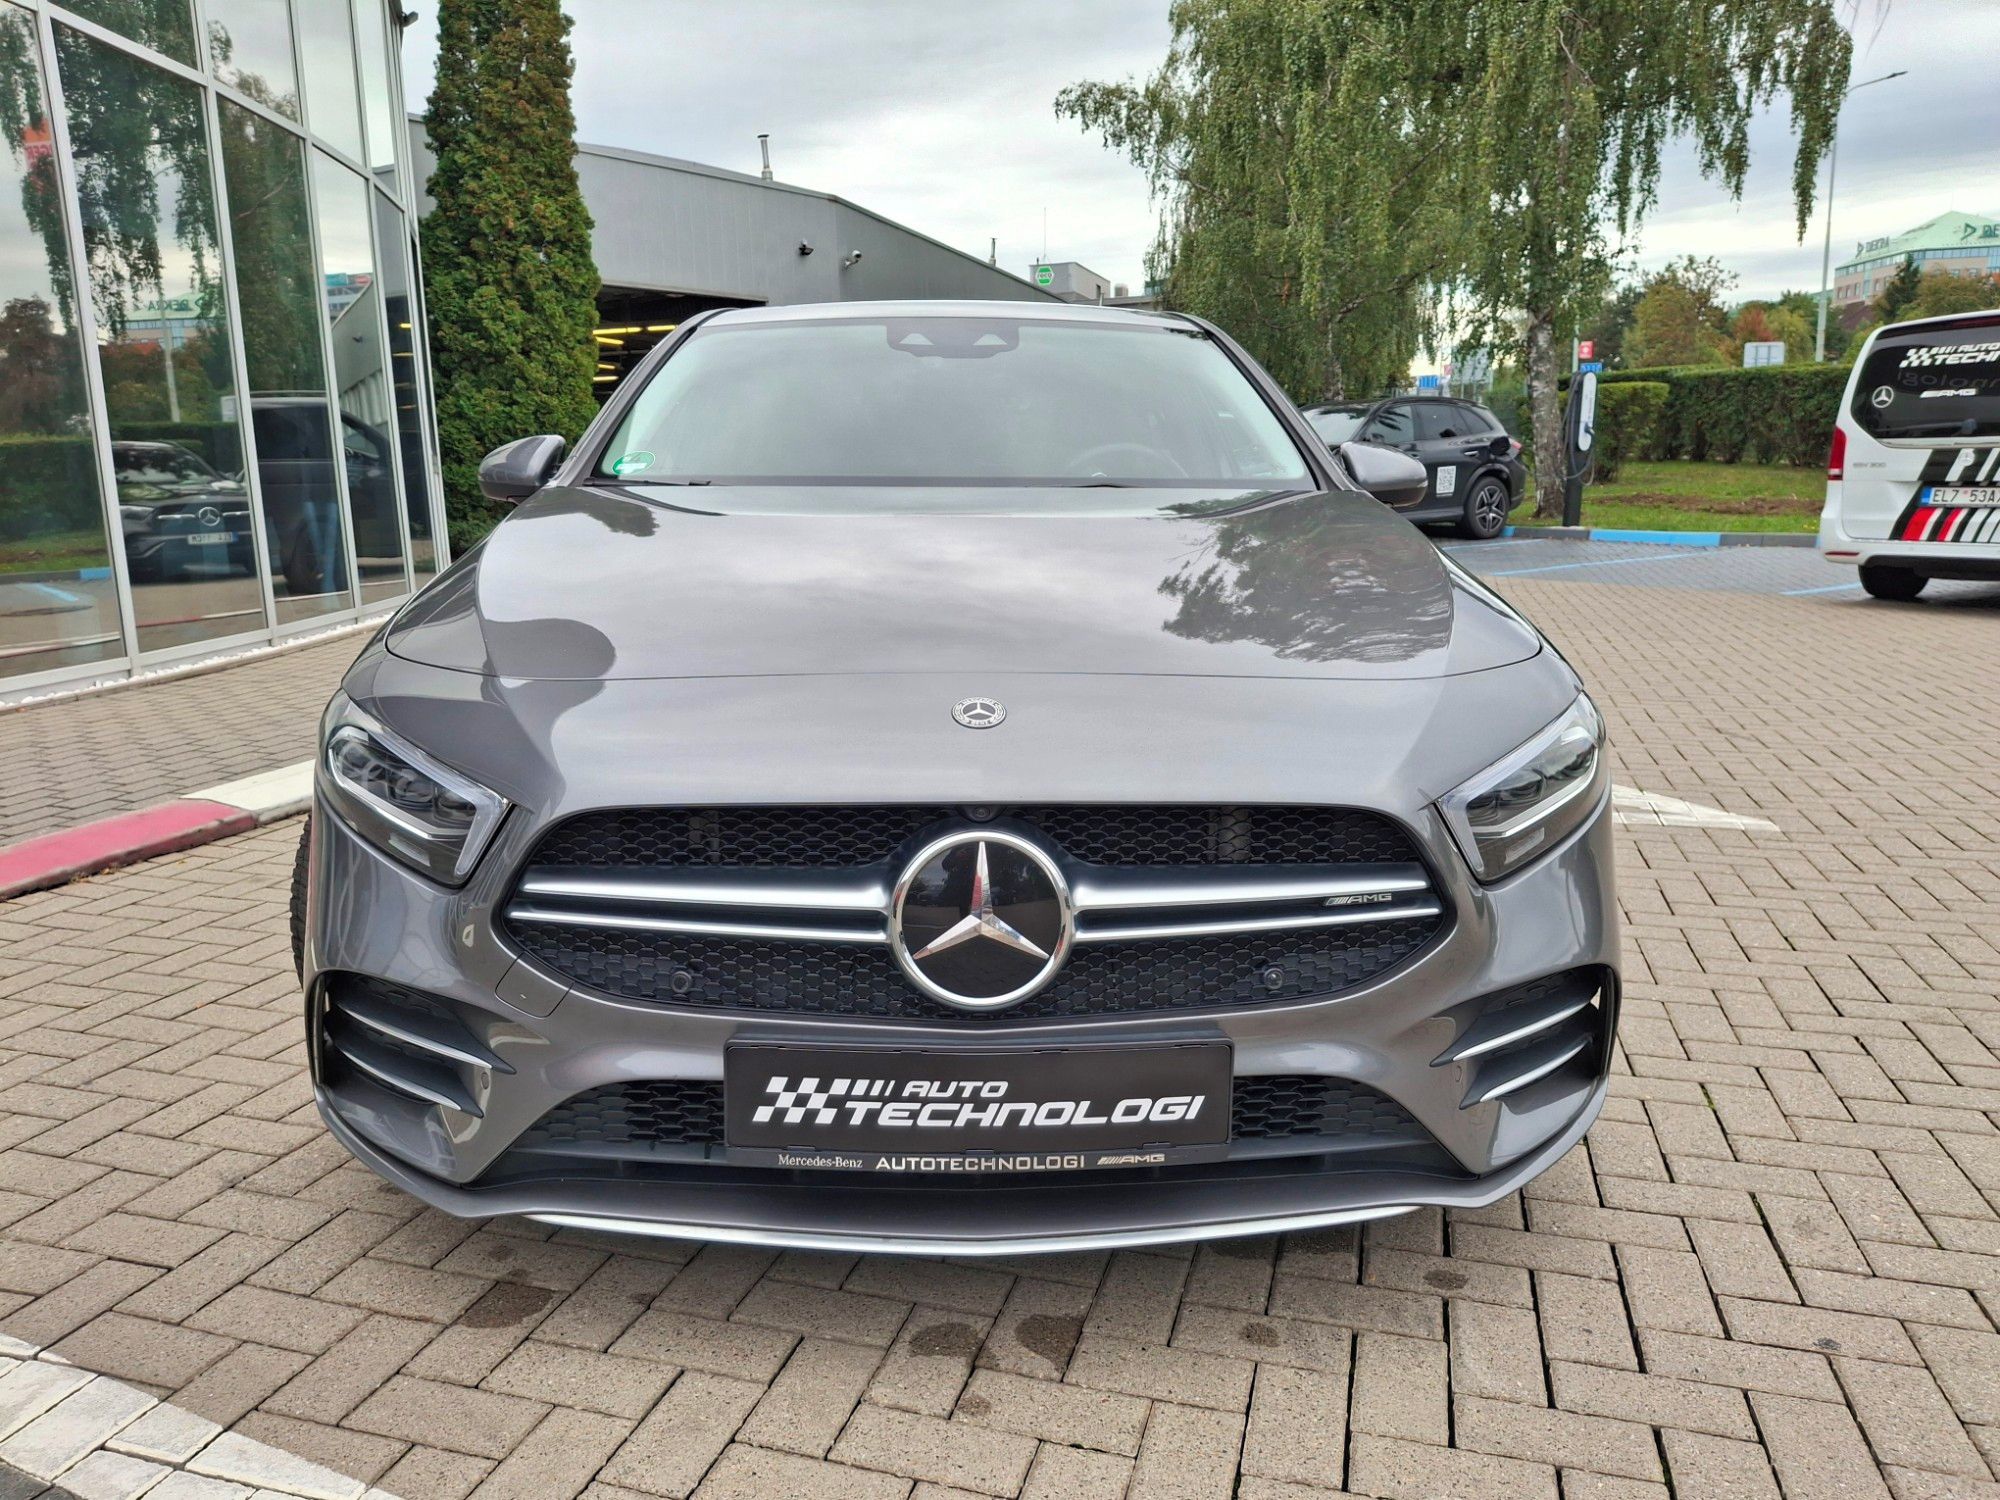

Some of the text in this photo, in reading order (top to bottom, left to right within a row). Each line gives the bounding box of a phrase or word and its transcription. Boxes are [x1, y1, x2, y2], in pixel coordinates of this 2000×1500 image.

[1958, 342, 2000, 353] AUTO
[1932, 489, 2000, 503] EL7 53A
[1346, 892, 1392, 904] AMG
[902, 1080, 1009, 1098] AUTO
[845, 1095, 1206, 1128] TECHNOLOGI
[778, 1153, 1166, 1171] Mercedes-Benz AUTOTECHNOLOGI AMG
